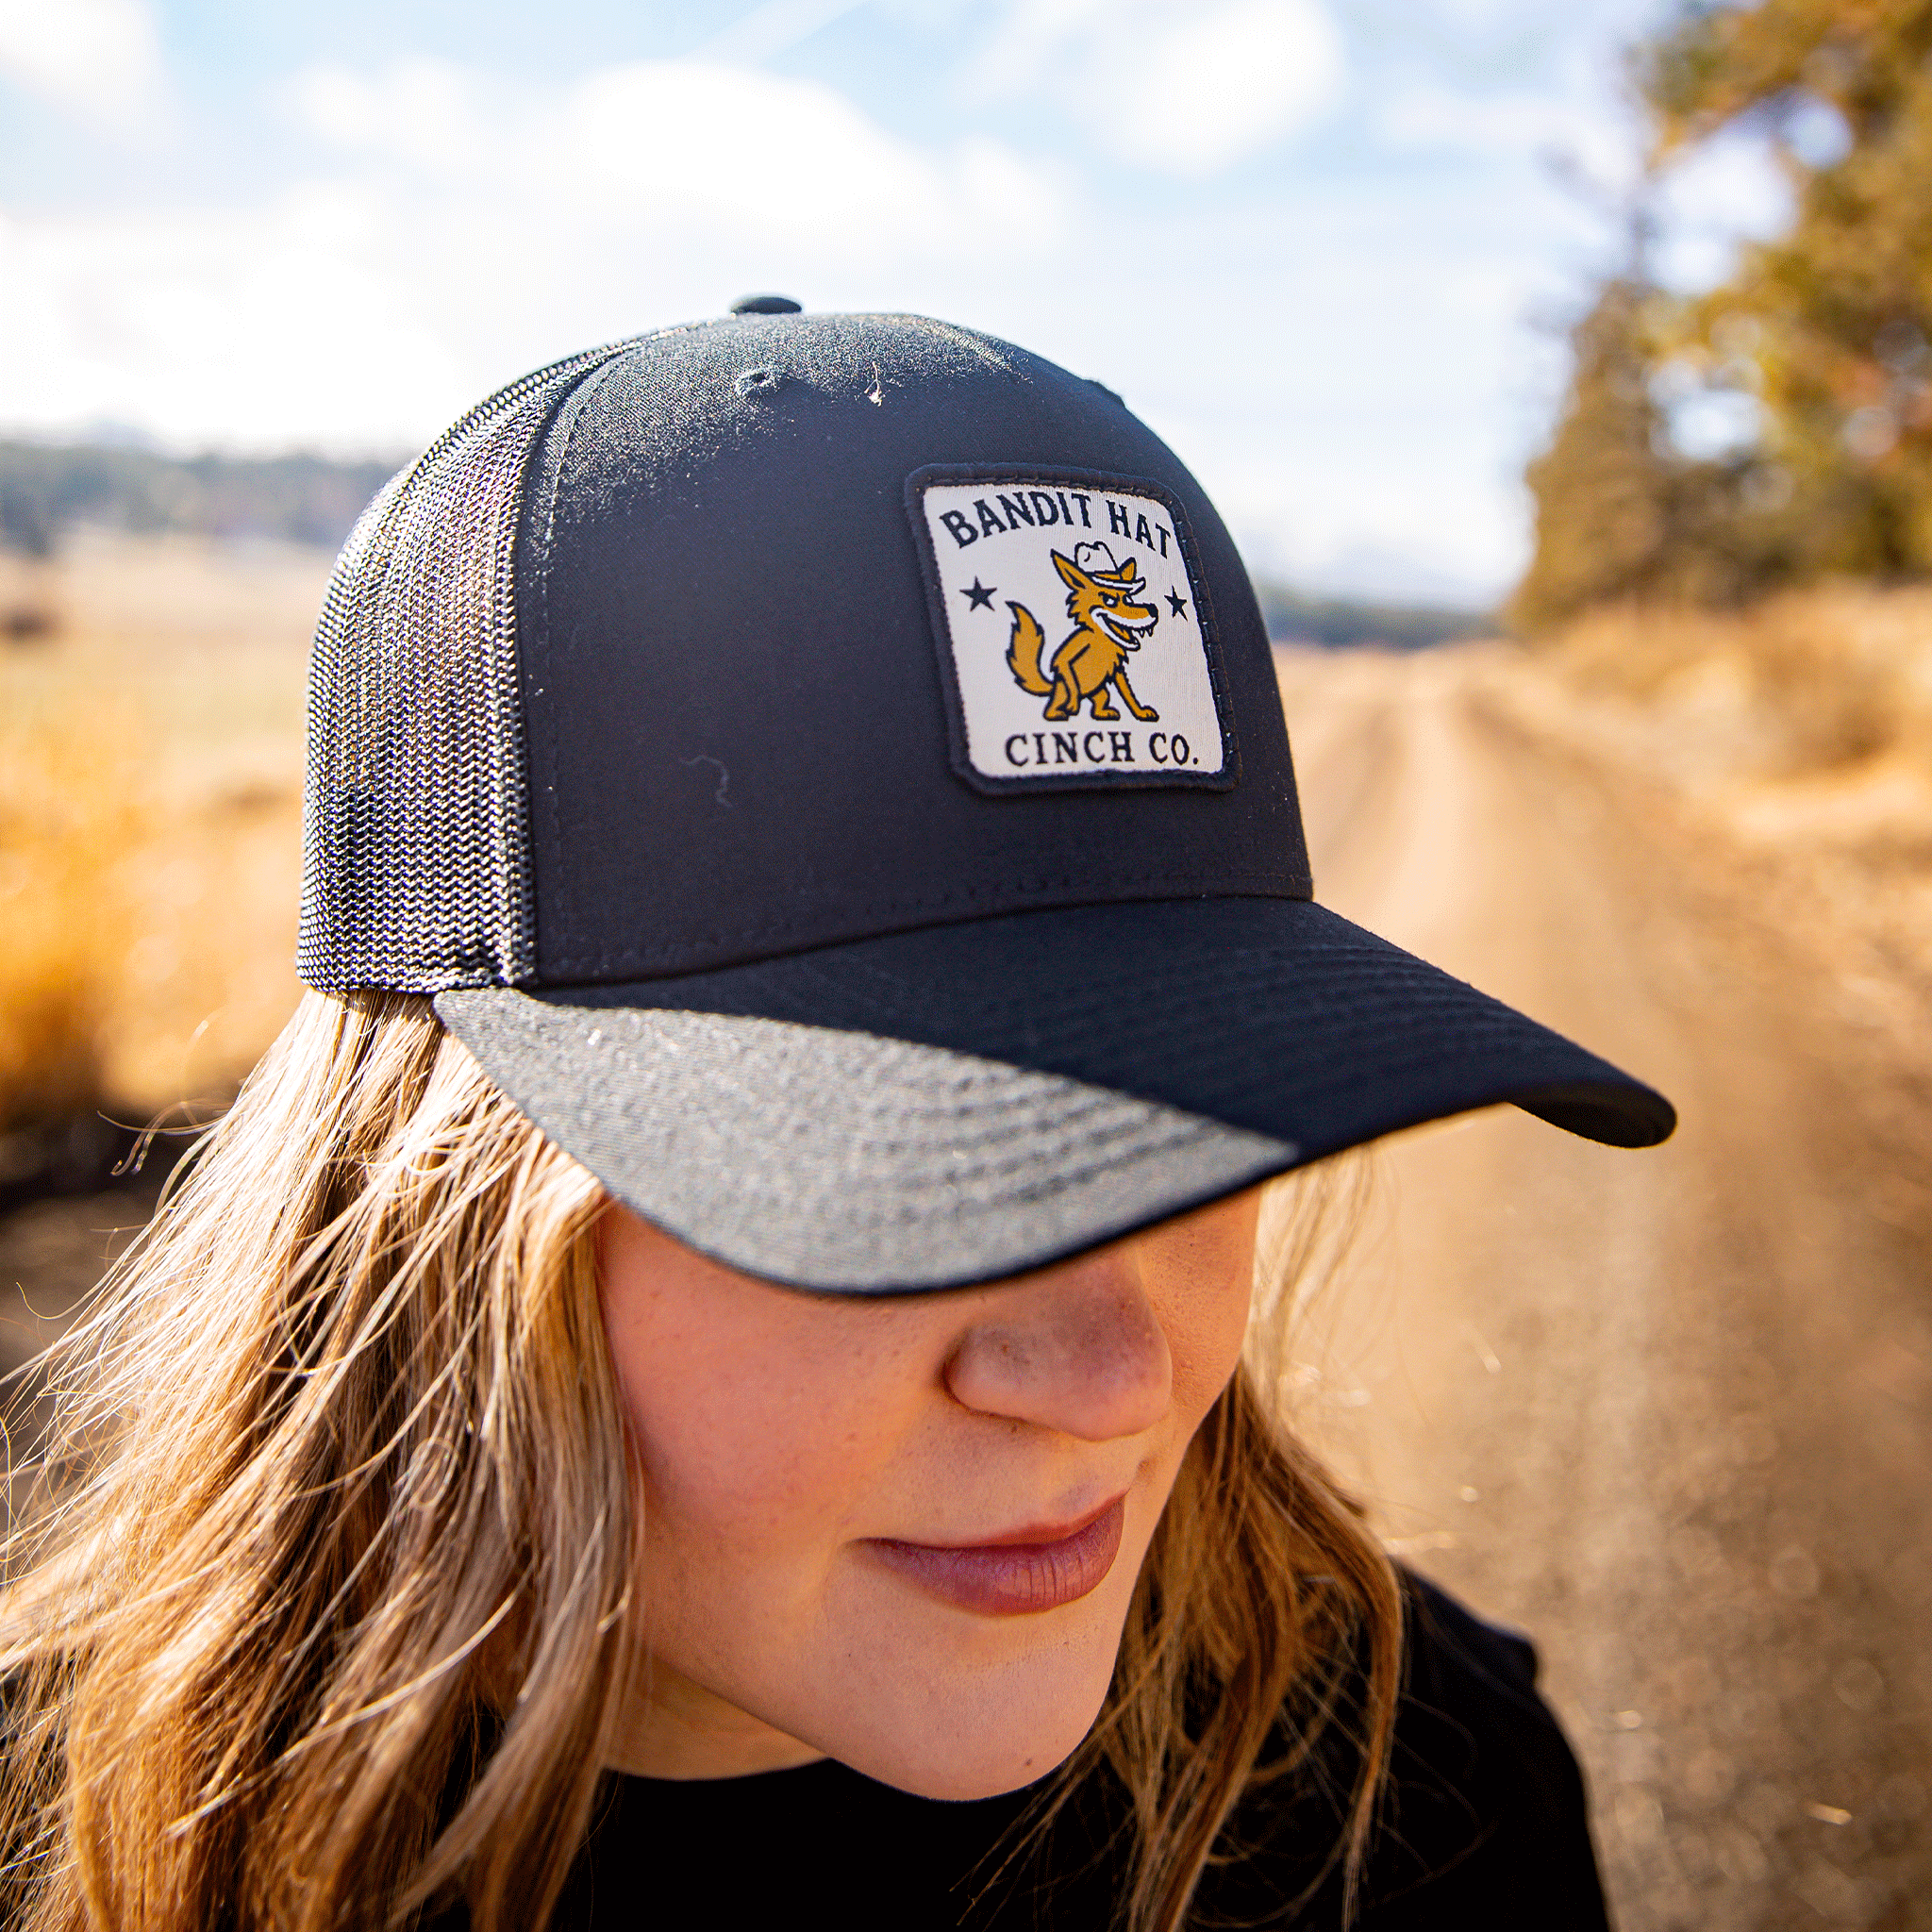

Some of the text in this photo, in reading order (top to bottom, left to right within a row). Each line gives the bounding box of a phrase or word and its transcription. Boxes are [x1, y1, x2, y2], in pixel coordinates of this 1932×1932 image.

[939, 491, 1171, 559] BANDIT HAT
[1005, 731, 1198, 766] CINCH CO.
